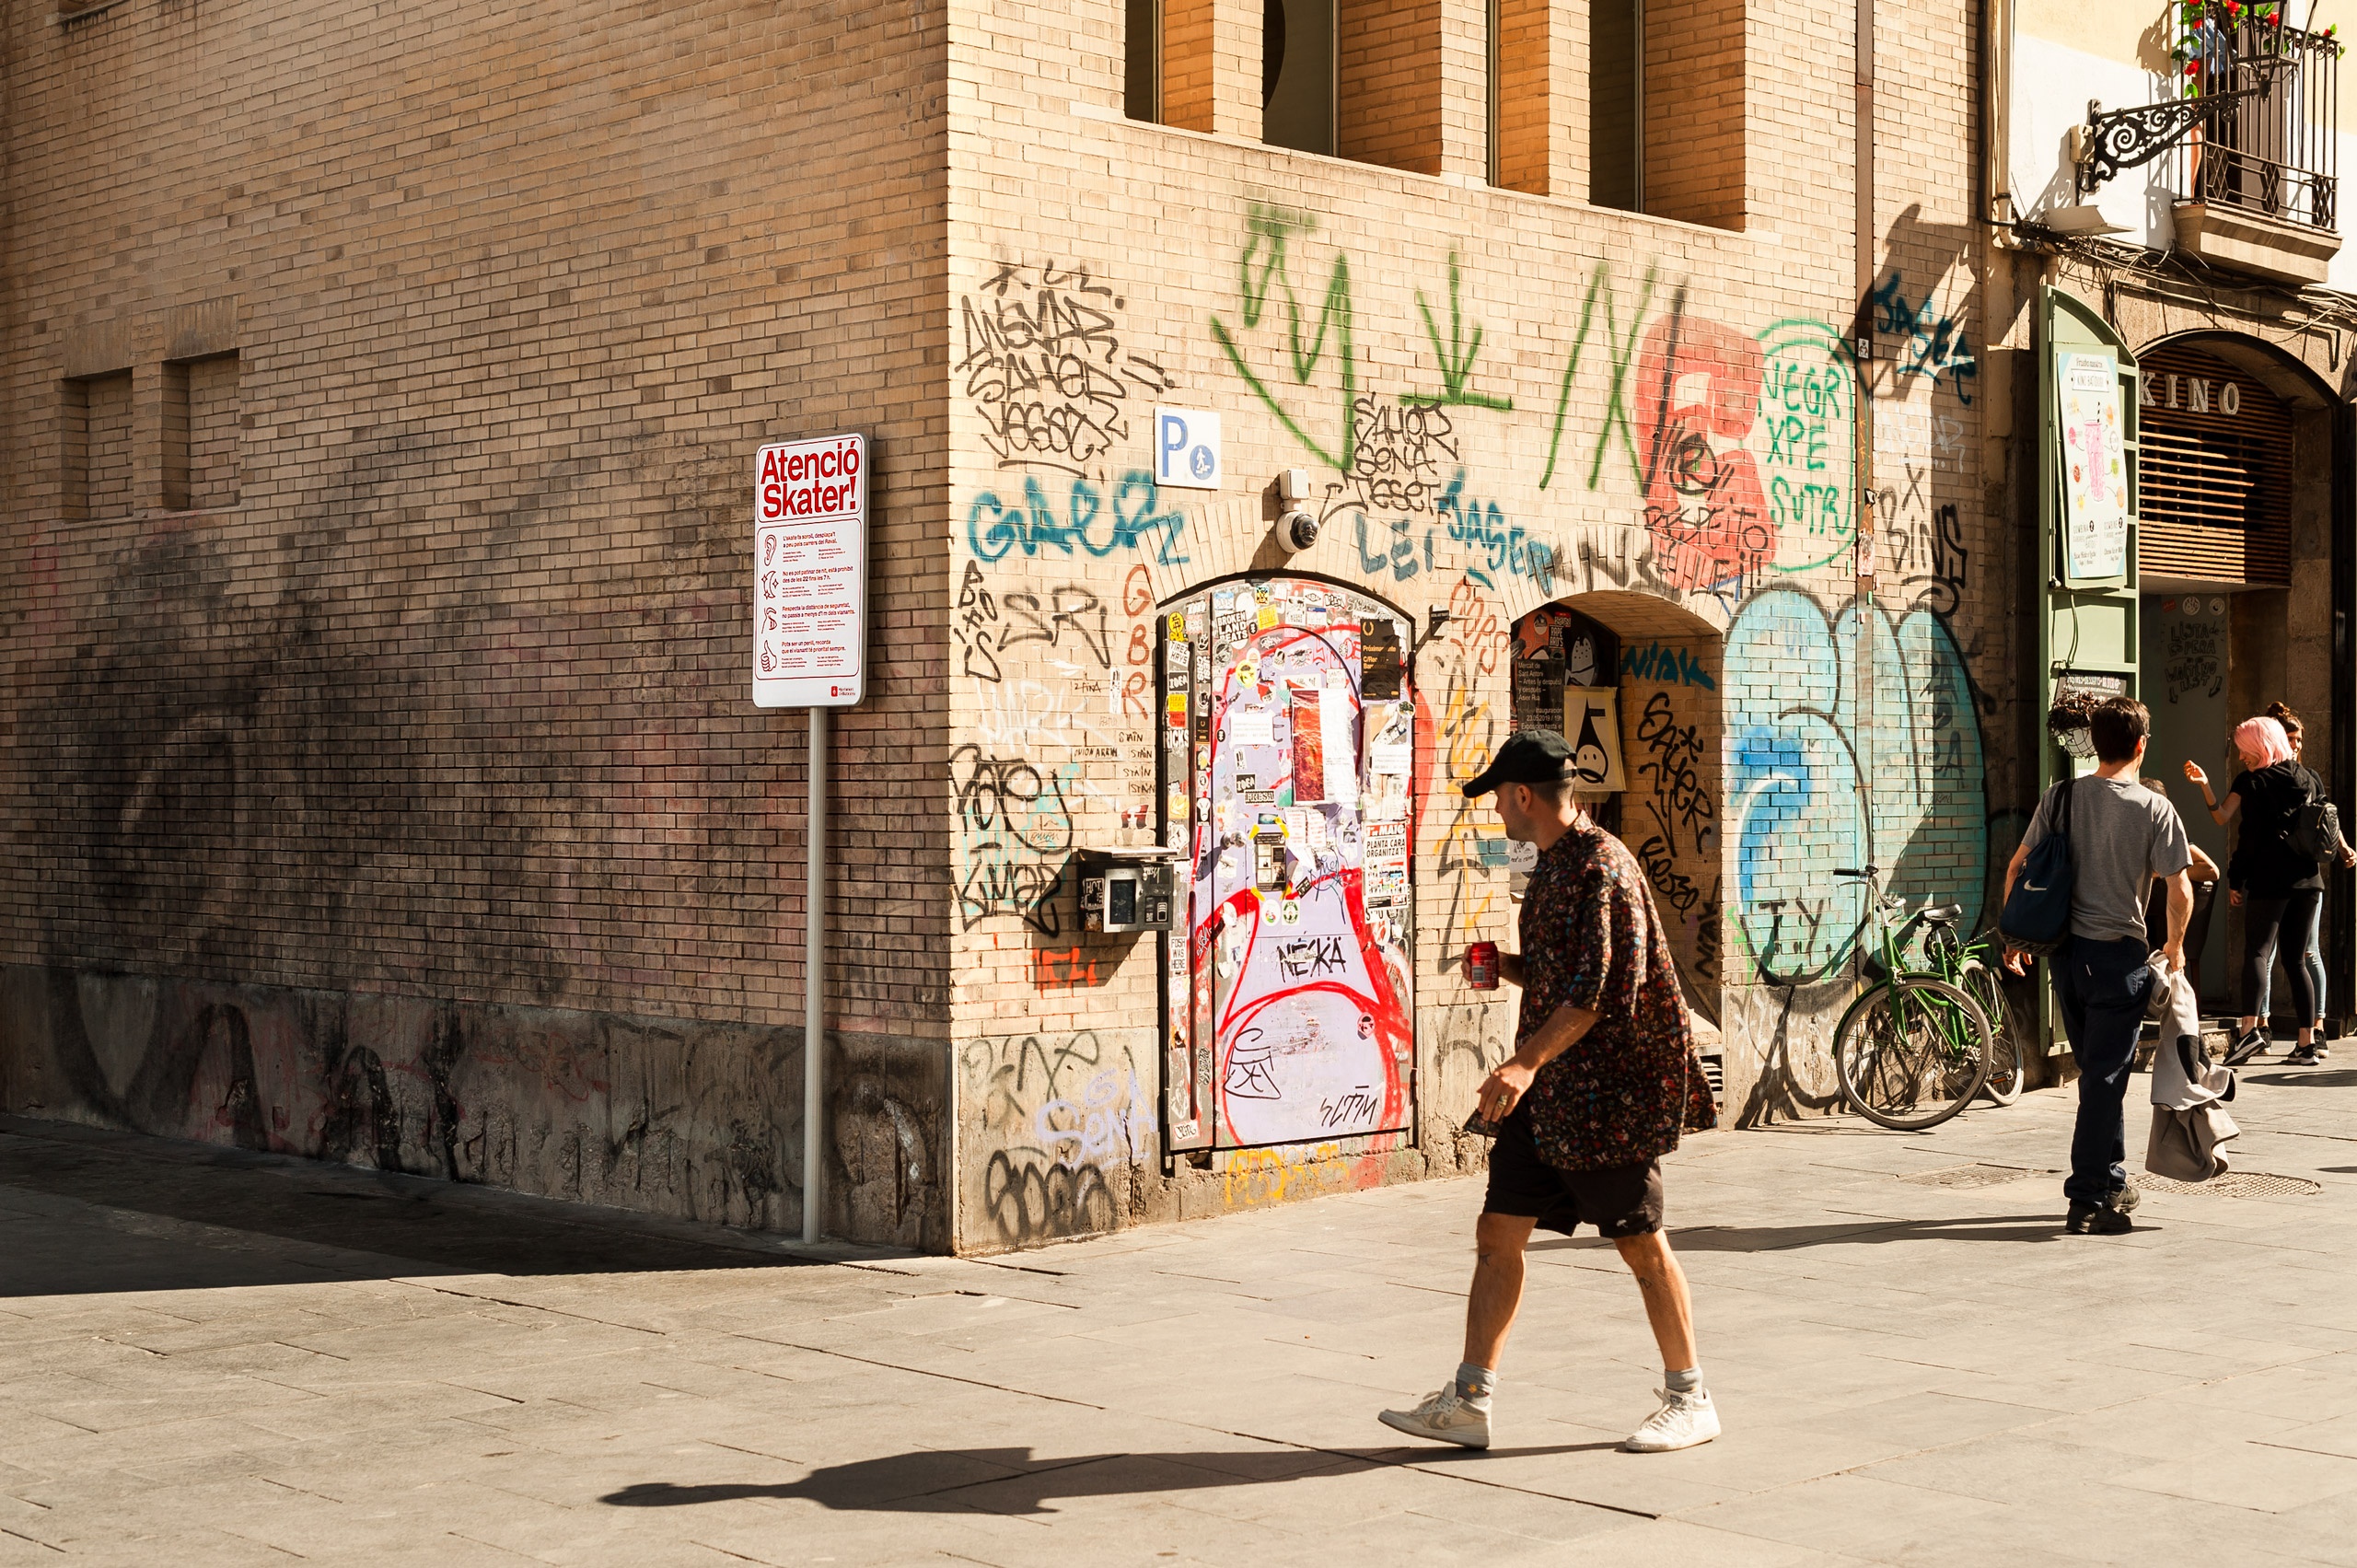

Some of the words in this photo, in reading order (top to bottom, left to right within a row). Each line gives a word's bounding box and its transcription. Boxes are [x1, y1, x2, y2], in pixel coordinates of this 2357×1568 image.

[2140, 370, 2241, 415] KINO
[1162, 415, 1189, 478] P
[761, 440, 860, 485] Atenció
[763, 476, 857, 518] Skater!
[1217, 611, 1247, 626] BROKEN
[1218, 622, 1248, 635] LAND
[1379, 825, 1405, 835] MAIG
[1367, 840, 1388, 849] PLANTA
[1390, 839, 1405, 847] CARA
[1171, 938, 1186, 948] FOSH
[1173, 948, 1185, 958] WAS
[1171, 959, 1186, 970] HERE
